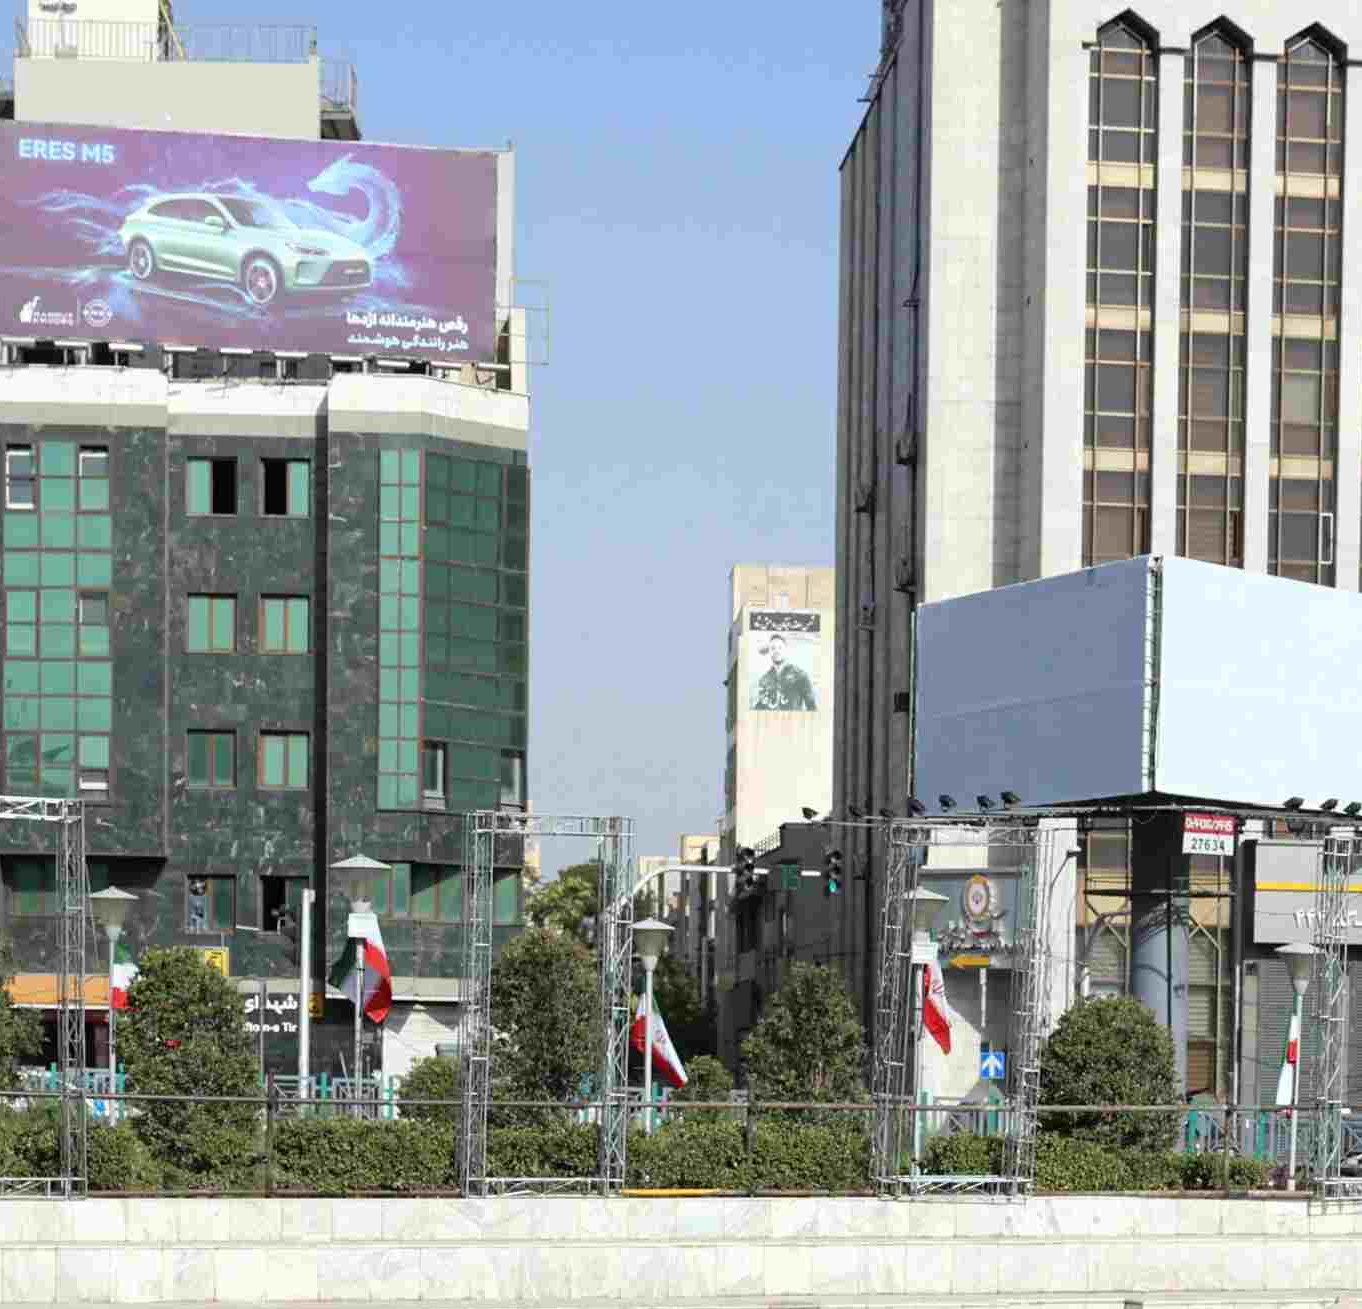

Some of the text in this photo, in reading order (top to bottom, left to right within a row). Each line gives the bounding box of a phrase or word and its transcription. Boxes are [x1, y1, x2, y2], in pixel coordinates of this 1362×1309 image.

[19, 138, 115, 164] ERES M5
[438, 315, 469, 335] رقص
[282, 1021, 298, 1032] Tir
